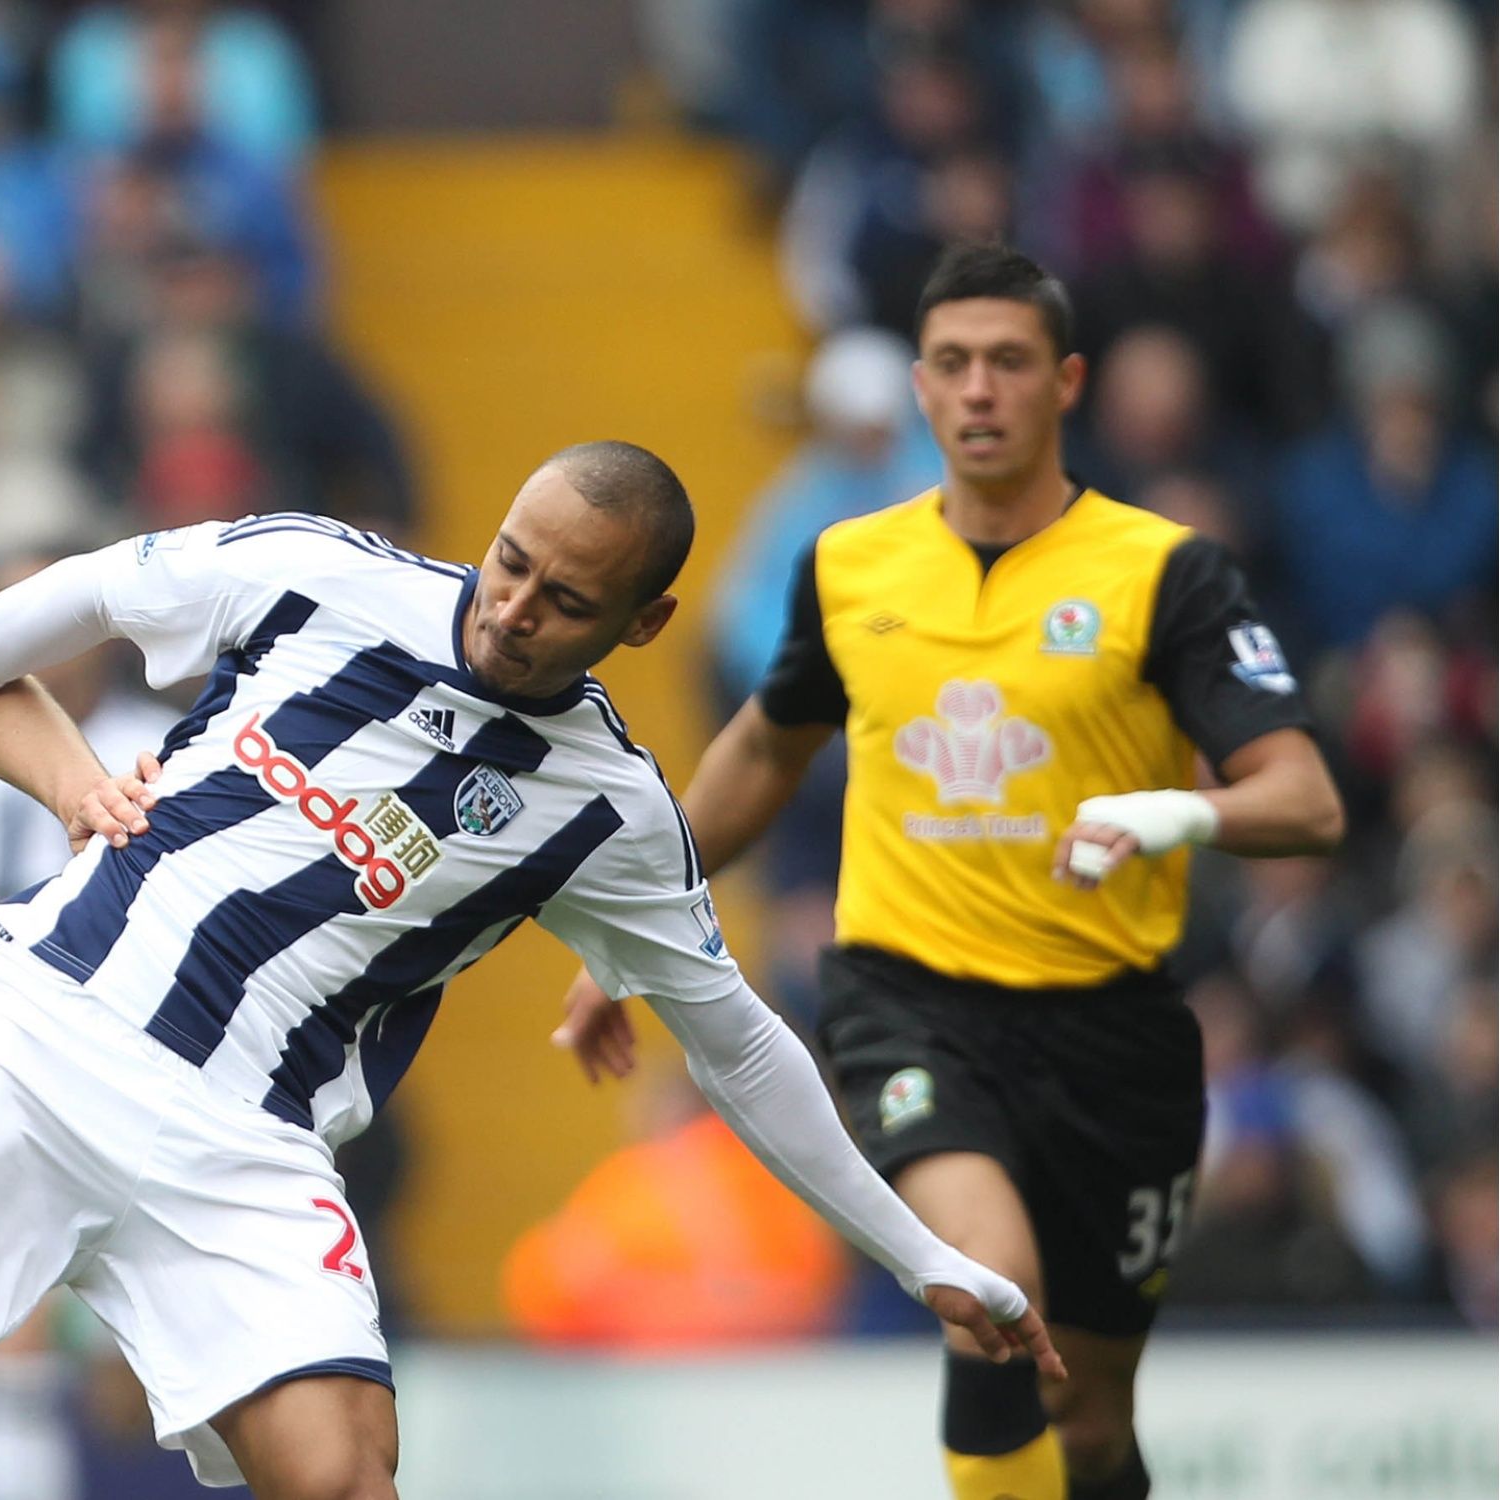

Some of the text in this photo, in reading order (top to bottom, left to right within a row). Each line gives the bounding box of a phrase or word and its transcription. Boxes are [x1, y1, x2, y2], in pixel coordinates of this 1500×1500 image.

[408, 711, 456, 751] adidas
[234, 712, 405, 909] bodog
[477, 771, 516, 815] ALBION
[364, 794, 441, 880] 博狗
[308, 1197, 367, 1285] 2
